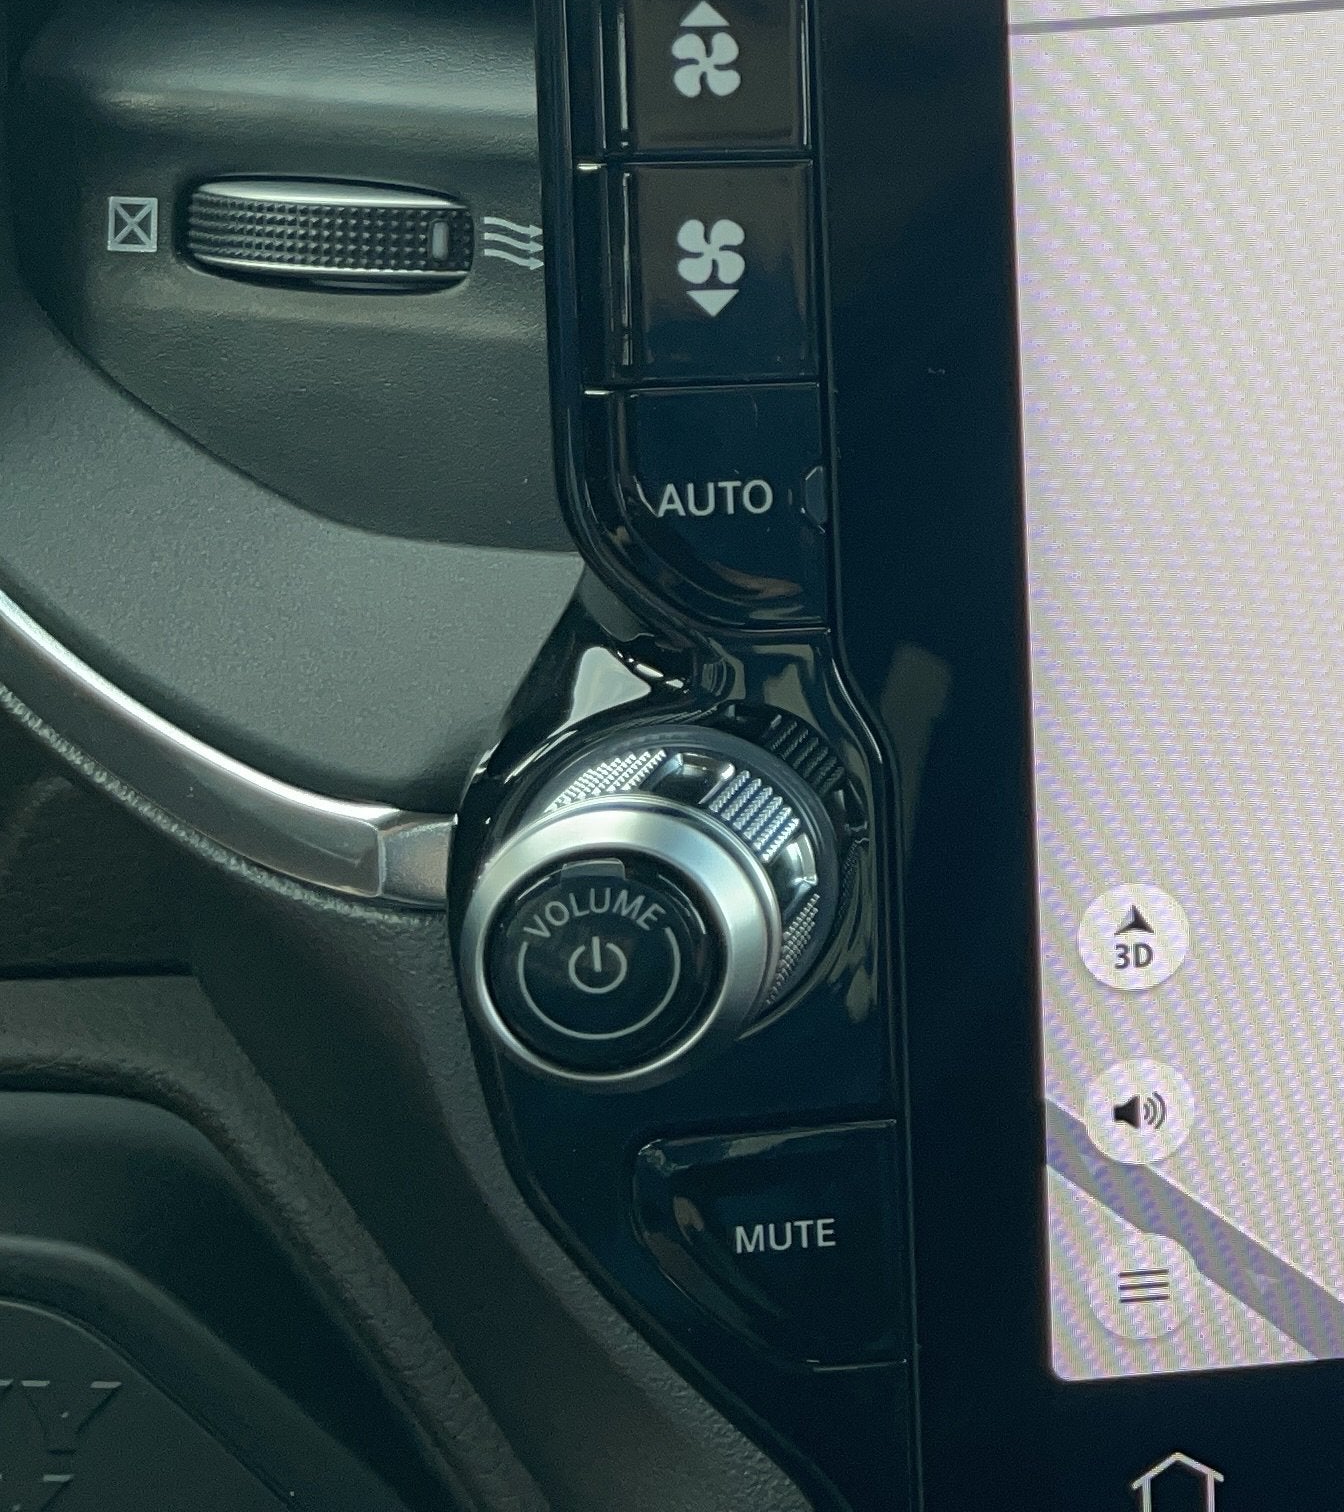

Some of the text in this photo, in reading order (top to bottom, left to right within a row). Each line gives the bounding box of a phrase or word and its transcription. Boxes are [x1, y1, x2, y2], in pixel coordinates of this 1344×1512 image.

[657, 479, 774, 518] AUTO
[523, 887, 667, 938] VOLUME
[1114, 943, 1154, 970] 3D
[735, 1219, 837, 1254] MUTE
